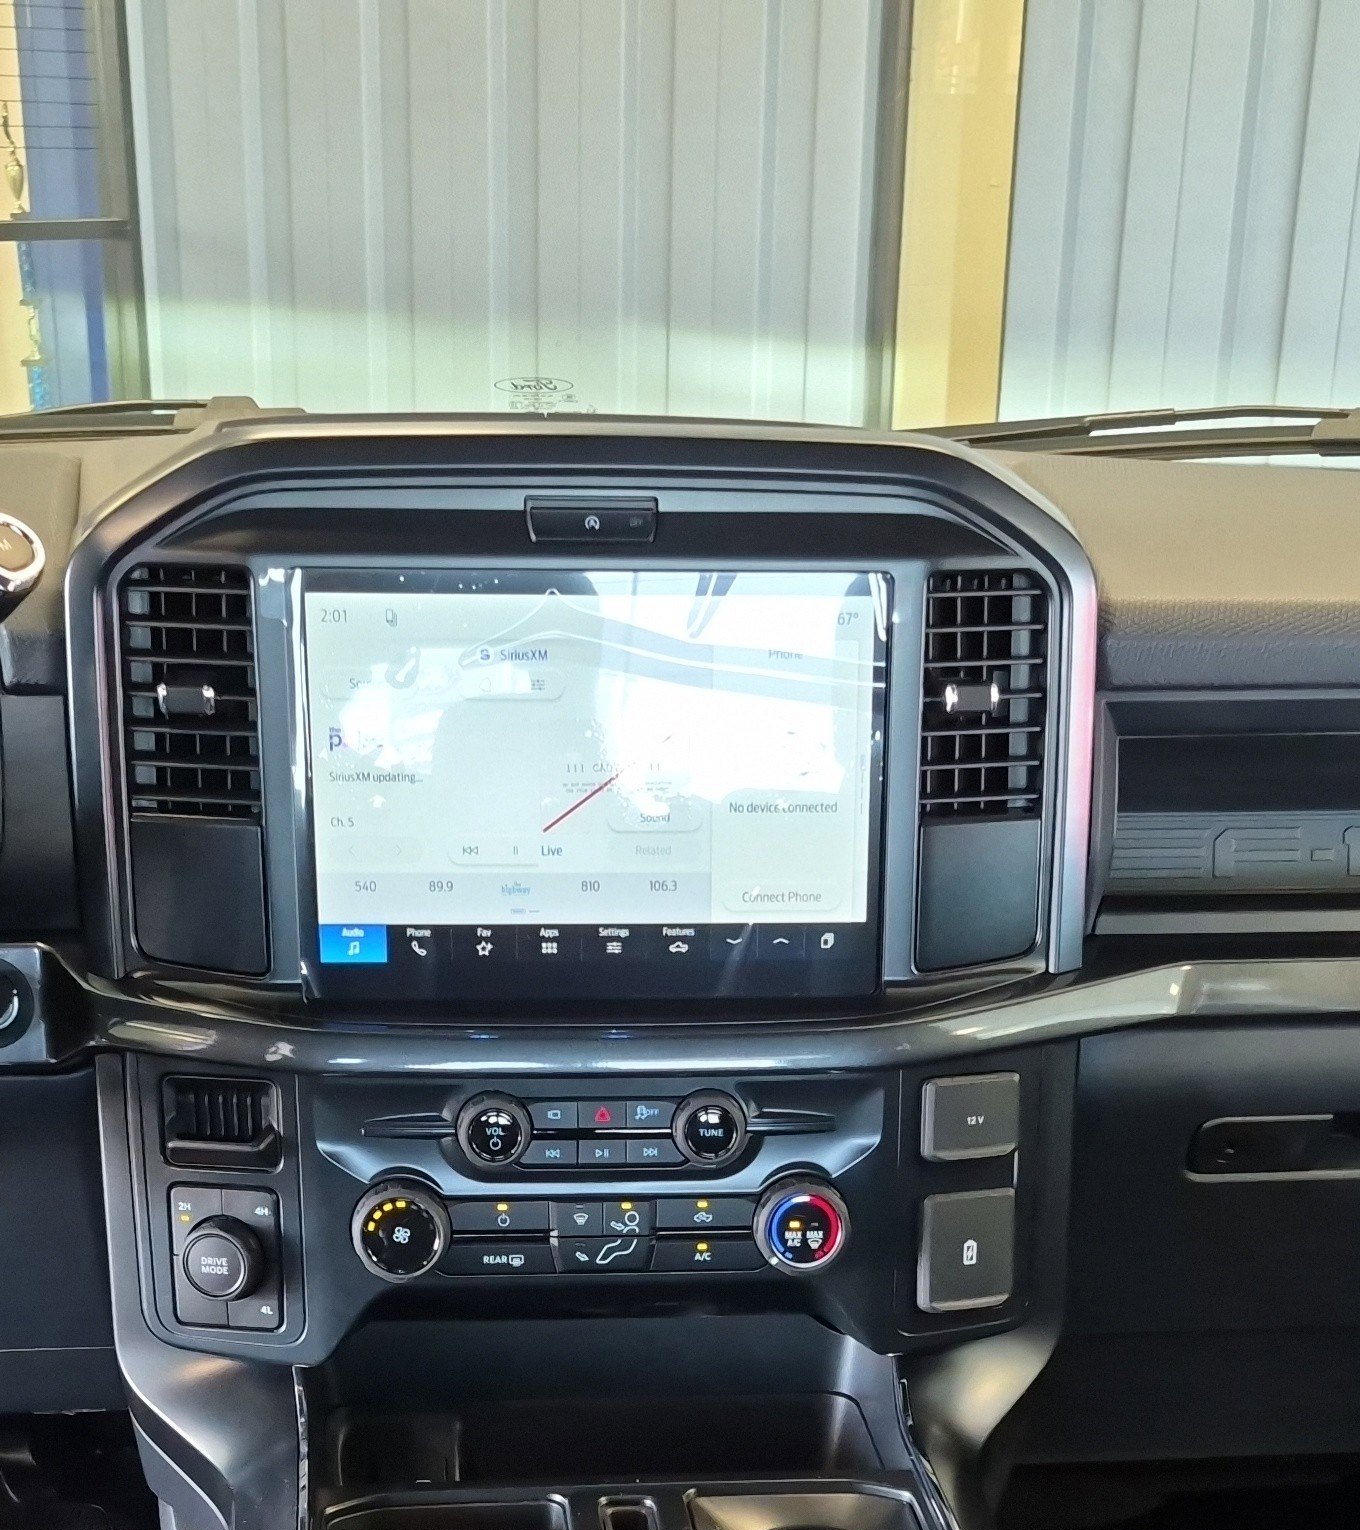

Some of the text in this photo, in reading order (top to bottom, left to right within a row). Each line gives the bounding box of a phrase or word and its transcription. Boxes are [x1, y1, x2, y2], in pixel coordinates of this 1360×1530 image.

[321, 610, 348, 623] 2:01
[500, 649, 548, 661] SiriusXM
[329, 772, 370, 783] SiriusXM
[729, 803, 744, 813] No
[746, 802, 780, 813] device
[347, 817, 354, 827] 5
[541, 845, 562, 856] Live
[635, 845, 671, 856] Related
[355, 880, 377, 892] 540
[429, 881, 453, 892] 89.9
[581, 880, 600, 892] 810
[649, 880, 677, 892] 106.3
[788, 892, 821, 903] Phone
[341, 928, 364, 938] Audio
[406, 928, 431, 937] Phone
[477, 928, 491, 937] Fav
[540, 928, 559, 938] Apps
[599, 927, 630, 937] Settings
[662, 927, 695, 936] Features
[486, 1127, 505, 1136] VOL
[698, 1128, 724, 1137] TUNE
[178, 1202, 191, 1211] 2H
[254, 1207, 268, 1216] 4H
[785, 1231, 802, 1239] MAX
[787, 1239, 801, 1247] A/C
[201, 1257, 228, 1266] DRIVE
[483, 1255, 507, 1264] REAR
[695, 1253, 712, 1261] A/C
[201, 1266, 228, 1274] MODE
[260, 1306, 273, 1314] 4L
